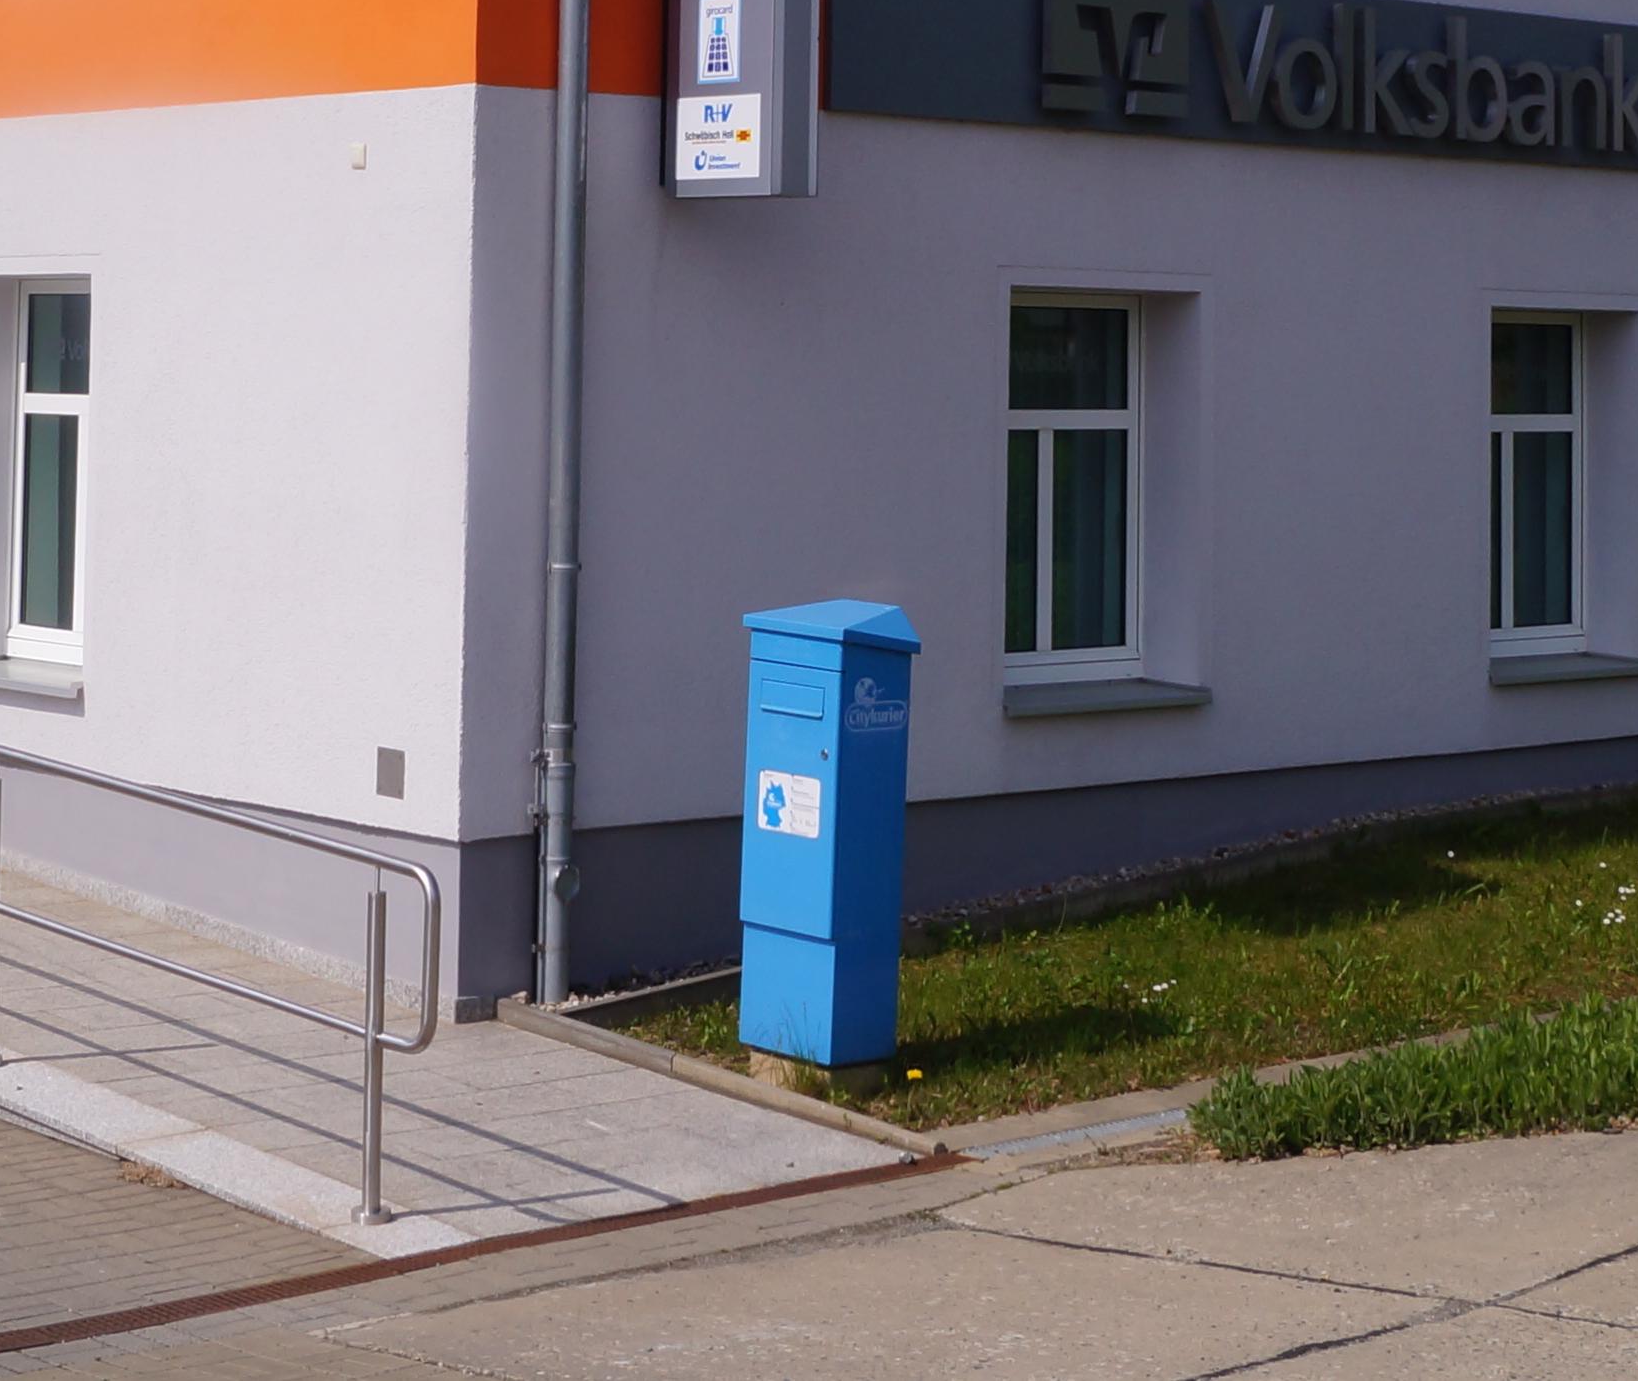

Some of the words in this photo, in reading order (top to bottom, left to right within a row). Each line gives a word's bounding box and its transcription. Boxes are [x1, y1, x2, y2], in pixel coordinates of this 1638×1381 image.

[705, 5, 733, 18] girocard
[703, 103, 734, 123] R+V
[848, 706, 905, 728] Citykurier
